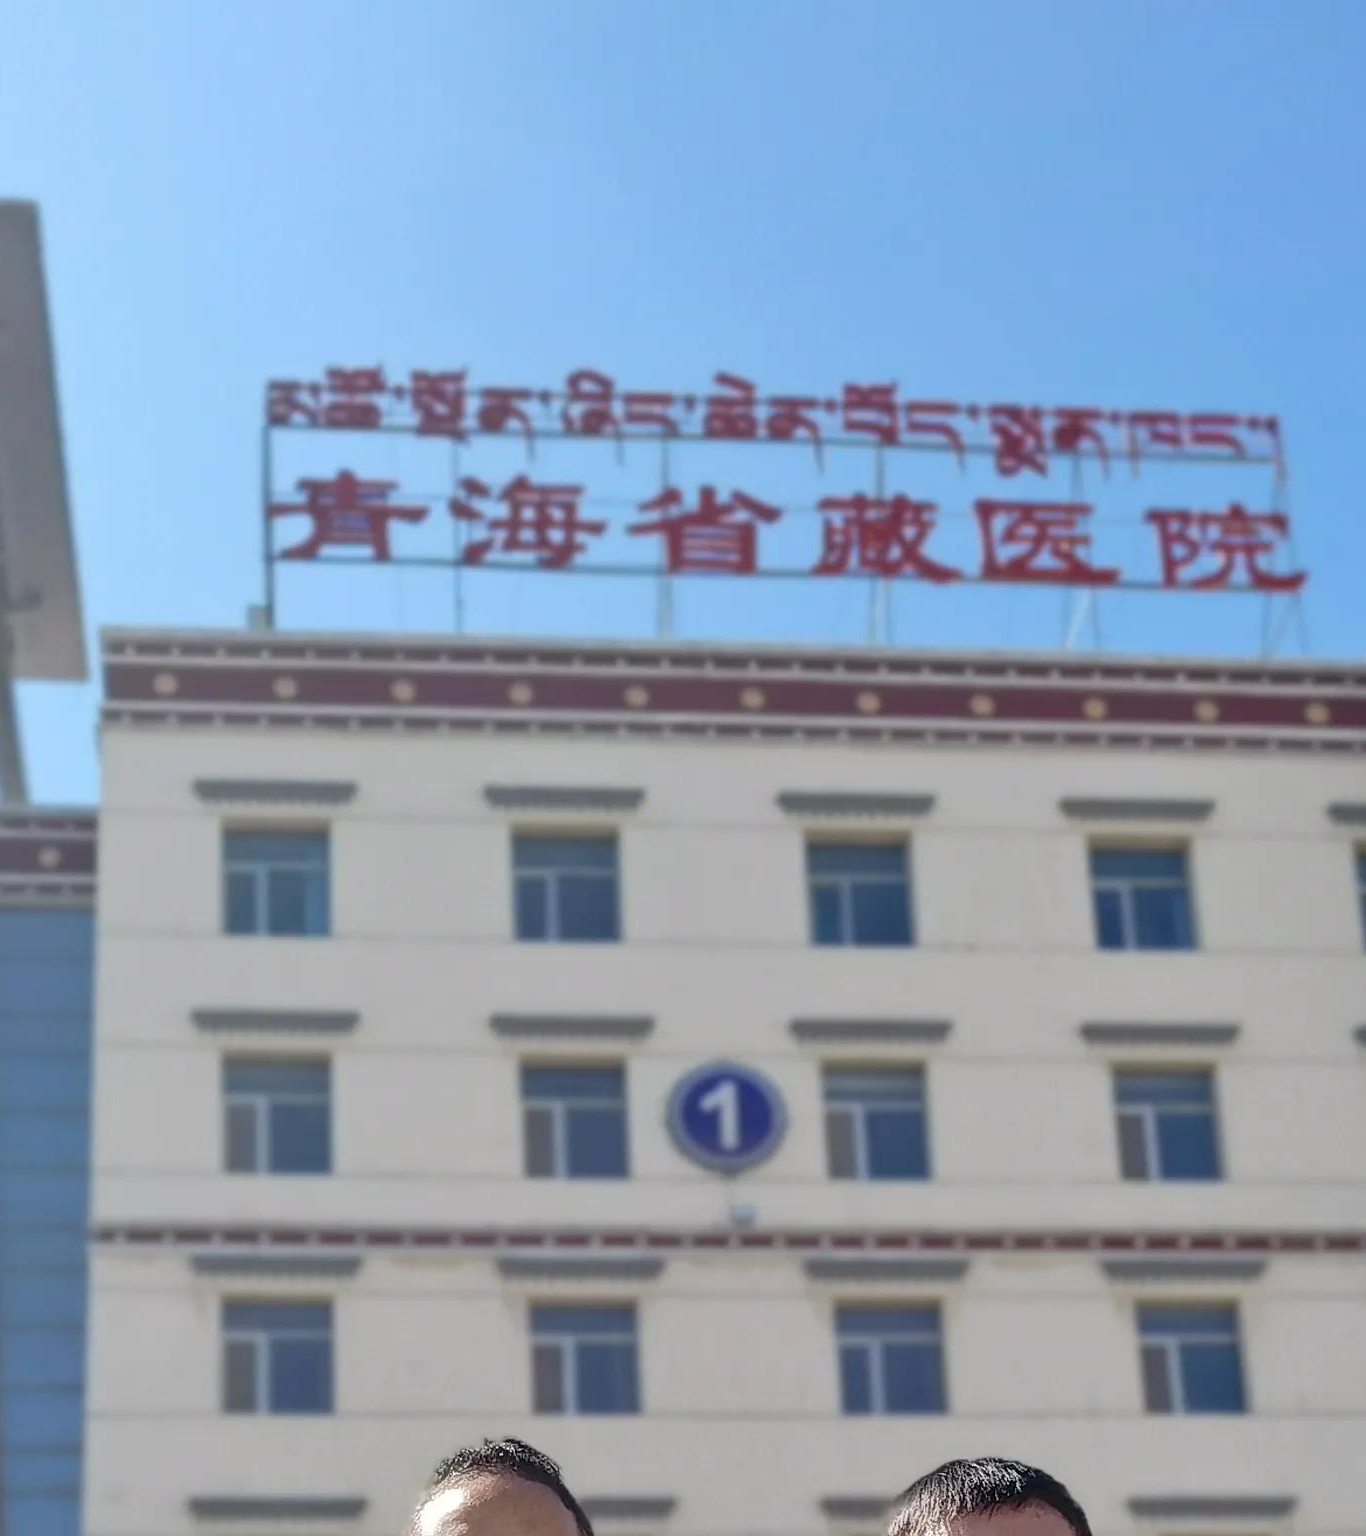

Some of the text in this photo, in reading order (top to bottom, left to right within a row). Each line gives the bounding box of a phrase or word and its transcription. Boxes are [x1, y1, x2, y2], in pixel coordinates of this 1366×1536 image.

[270, 469, 1309, 591] 青海省藏医院
[697, 1078, 741, 1151] 1
